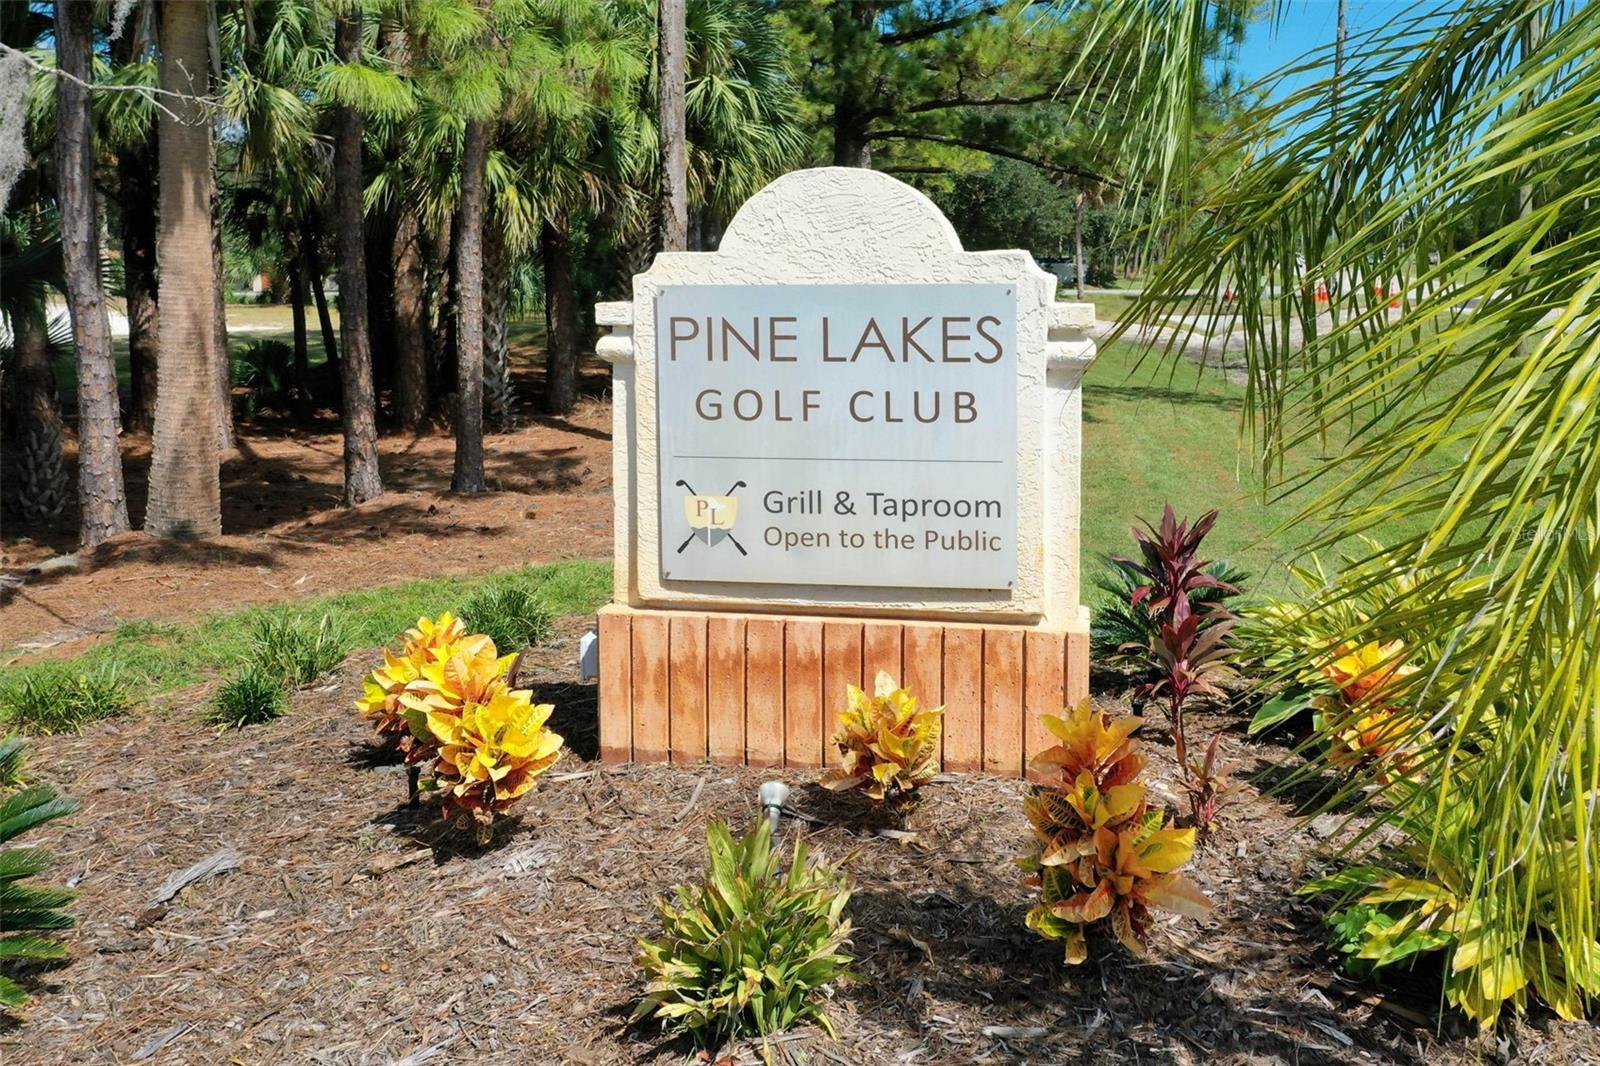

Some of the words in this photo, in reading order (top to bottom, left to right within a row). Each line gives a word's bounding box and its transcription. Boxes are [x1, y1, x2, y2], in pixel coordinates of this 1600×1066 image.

[669, 316, 798, 362] PINE
[822, 315, 1004, 364] LAKES
[695, 388, 821, 422] GOLF
[849, 390, 979, 424] CLUB
[763, 490, 822, 515] Grill
[833, 491, 857, 516] &
[866, 492, 1002, 522] Taproom
[763, 526, 830, 551] Open
[838, 528, 865, 549] to
[873, 528, 915, 550] the
[925, 530, 1002, 552] Public
